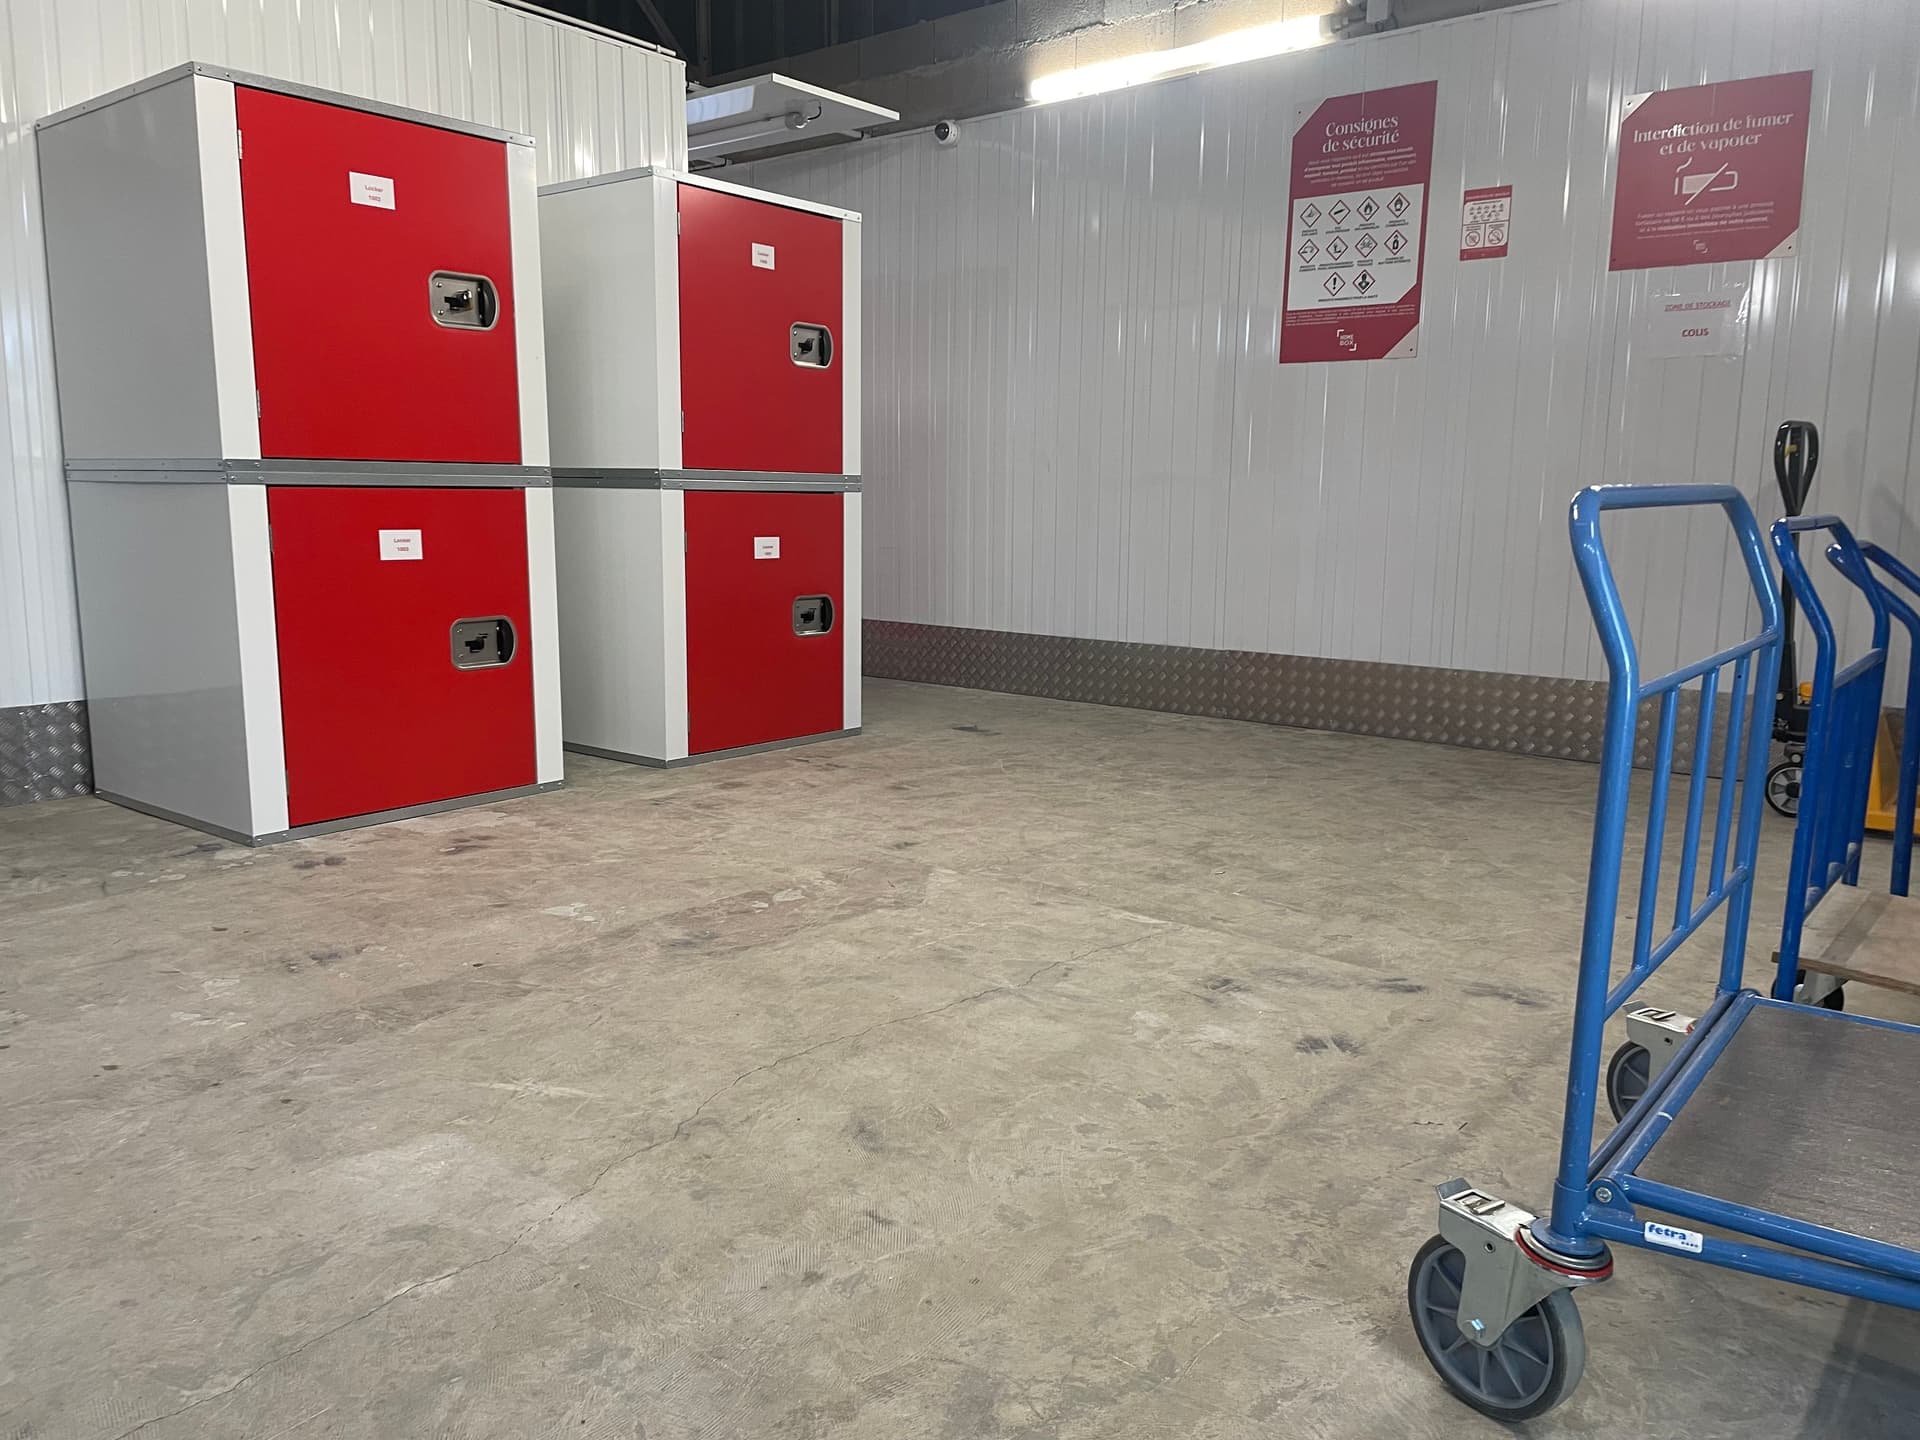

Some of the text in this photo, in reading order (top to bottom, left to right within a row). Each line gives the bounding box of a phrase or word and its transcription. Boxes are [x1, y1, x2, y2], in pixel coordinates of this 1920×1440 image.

[1326, 115, 1399, 137] Consignes
[1633, 112, 1794, 143] Interdiction de fumer
[1322, 129, 1400, 154] de sécurité
[1659, 132, 1762, 156] et de vapoter
[1681, 327, 1710, 337] COLIS
[1648, 1224, 1687, 1240] fetra
